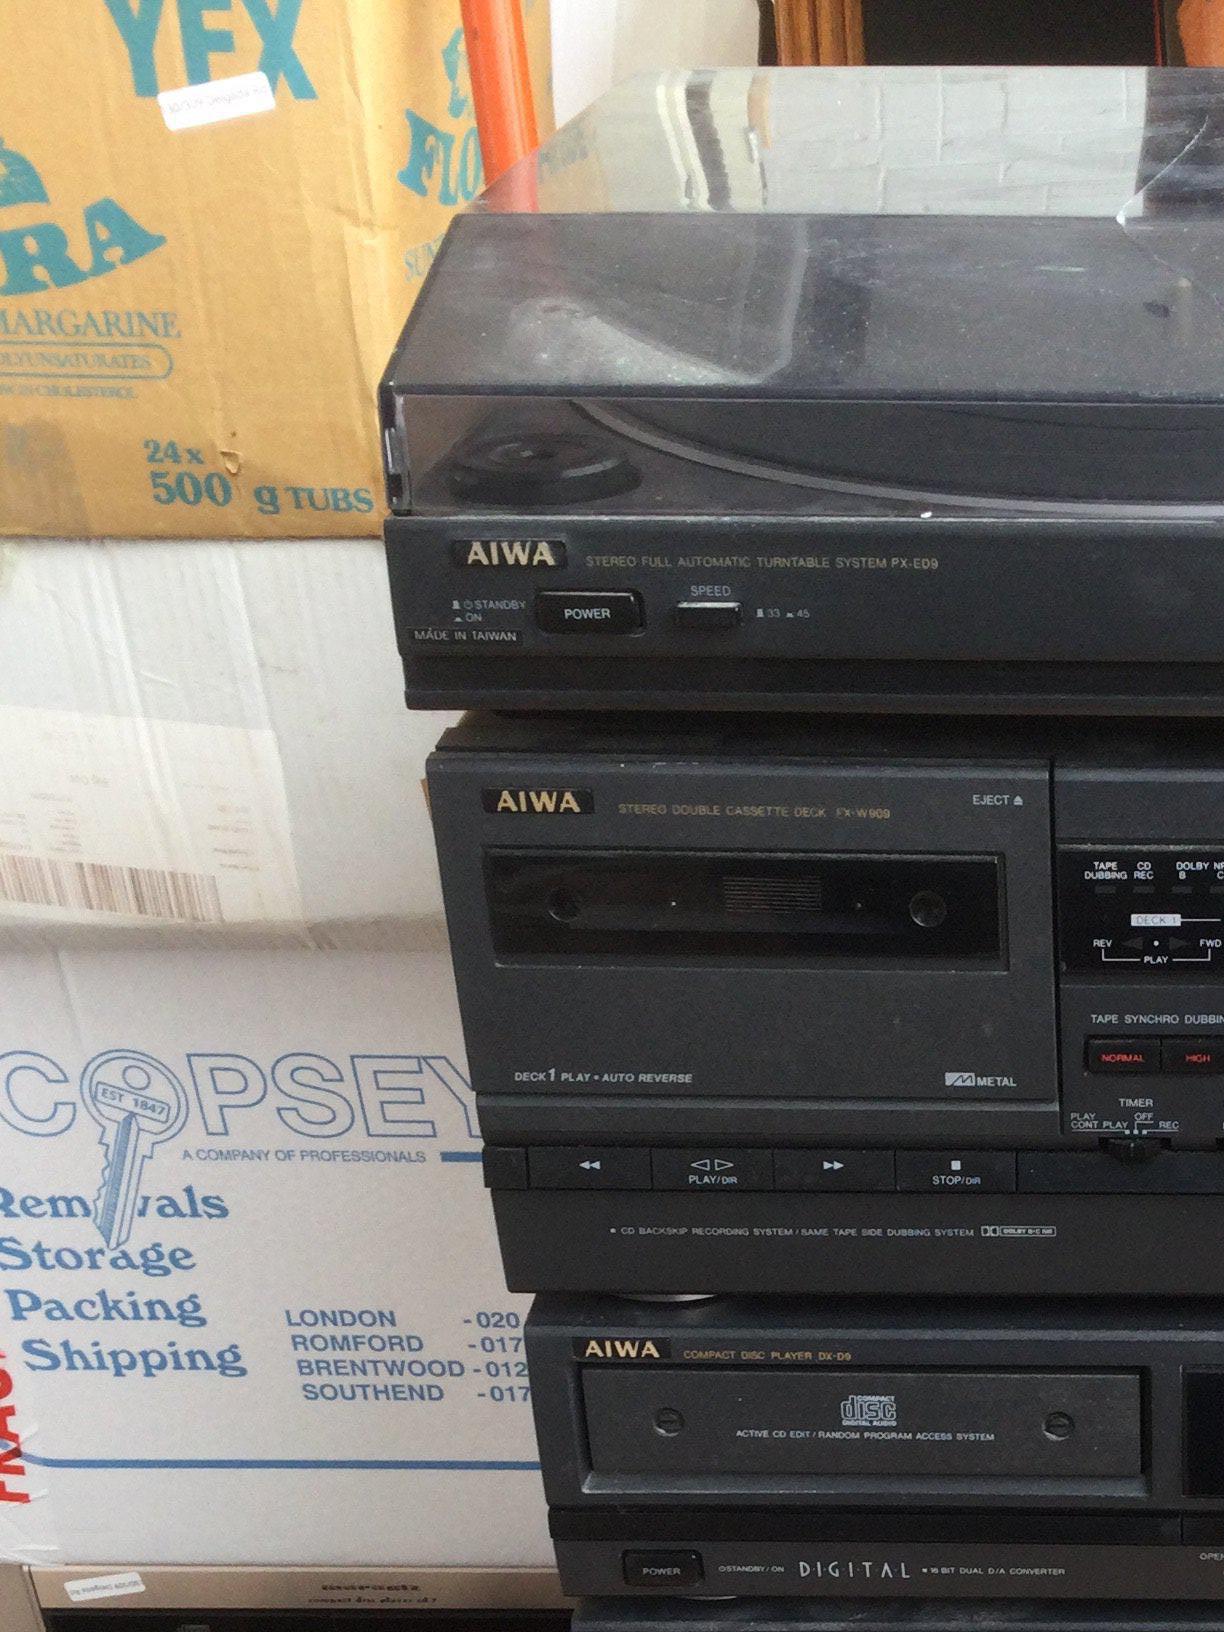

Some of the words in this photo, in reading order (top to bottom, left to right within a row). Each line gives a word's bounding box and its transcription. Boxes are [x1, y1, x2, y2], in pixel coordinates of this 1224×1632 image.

[143, 440, 181, 465] 24
[150, 471, 233, 508] 500
[254, 485, 280, 515] g
[285, 488, 374, 514] TUBS
[467, 541, 556, 566] AIWA
[585, 556, 636, 568] STEREO
[641, 556, 672, 567] FULL
[677, 556, 751, 568] AUTOMATIC
[756, 557, 830, 569] TURNTABLE
[835, 557, 887, 569] SYSTEM
[690, 585, 731, 597] SPEED
[564, 608, 611, 620] POWER
[414, 629, 448, 641] MADE
[455, 630, 467, 641] IN
[472, 630, 517, 642] TAIWAN
[497, 790, 581, 814] AIWA
[972, 794, 1010, 806] EJECT
[618, 804, 668, 815] STEREO
[672, 804, 721, 816] DOUBLE
[726, 805, 790, 817] CASSETTE
[794, 806, 827, 818] DECK
[1093, 862, 1118, 871] TAPE
[1137, 862, 1151, 871] CD
[1176, 862, 1210, 871] DOLBY
[1084, 871, 1127, 880] DUBBING
[1133, 871, 1154, 880] REC
[1093, 939, 1112, 948] REV
[1200, 939, 1222, 948] FWD
[1144, 955, 1169, 965] PLAY
[1091, 1014, 1119, 1024] TAPE
[1124, 1014, 1179, 1025] SYNCHRO
[1101, 1054, 1145, 1063] NORMAL
[1185, 1054, 1211, 1063] HIGH
[561, 1073, 590, 1083] PLAY
[602, 1073, 635, 1083] AUTO
[638, 1073, 693, 1084] REVERSE
[977, 1077, 1017, 1088] METAL
[101, 1088, 124, 1103] EST
[133, 1096, 167, 1115] 1847
[1118, 1099, 1154, 1108] TIMER
[1071, 1113, 1096, 1121] PLAY
[1071, 1121, 1099, 1130] CONT
[1102, 1121, 1128, 1130] PLAY
[1159, 1120, 1179, 1129] REC
[195, 1149, 270, 1162] COMPANY
[275, 1149, 297, 1162] OF
[300, 1150, 427, 1164] PROFESSIONALS
[688, 1174, 738, 1185] PLAY/DIR
[932, 1174, 980, 1185] STOP/DIR
[0, 1184, 230, 1219] Remvals
[692, 1226, 749, 1236] RECORDING
[833, 1226, 858, 1236] TAPE
[887, 1226, 931, 1236] DUBBING
[936, 1226, 974, 1236] SYSTEM
[0, 1236, 197, 1277] Storage
[3, 1288, 208, 1328] Packing
[285, 1309, 398, 1328] LONDON
[290, 1333, 424, 1352] ROMFORD
[585, 1341, 660, 1358] AIWA
[683, 1350, 736, 1360] COMPACT
[22, 1336, 248, 1379] Shipping
[296, 1359, 466, 1378] BRENTWOOD
[302, 1382, 445, 1402] SOUTHEND
[736, 1430, 770, 1440] ACTIVE
[864, 1431, 912, 1441] PROGRAM
[956, 1432, 995, 1442] SYSTEM
[642, 1567, 682, 1577] POWER
[1009, 1567, 1066, 1576] CONVERTER
